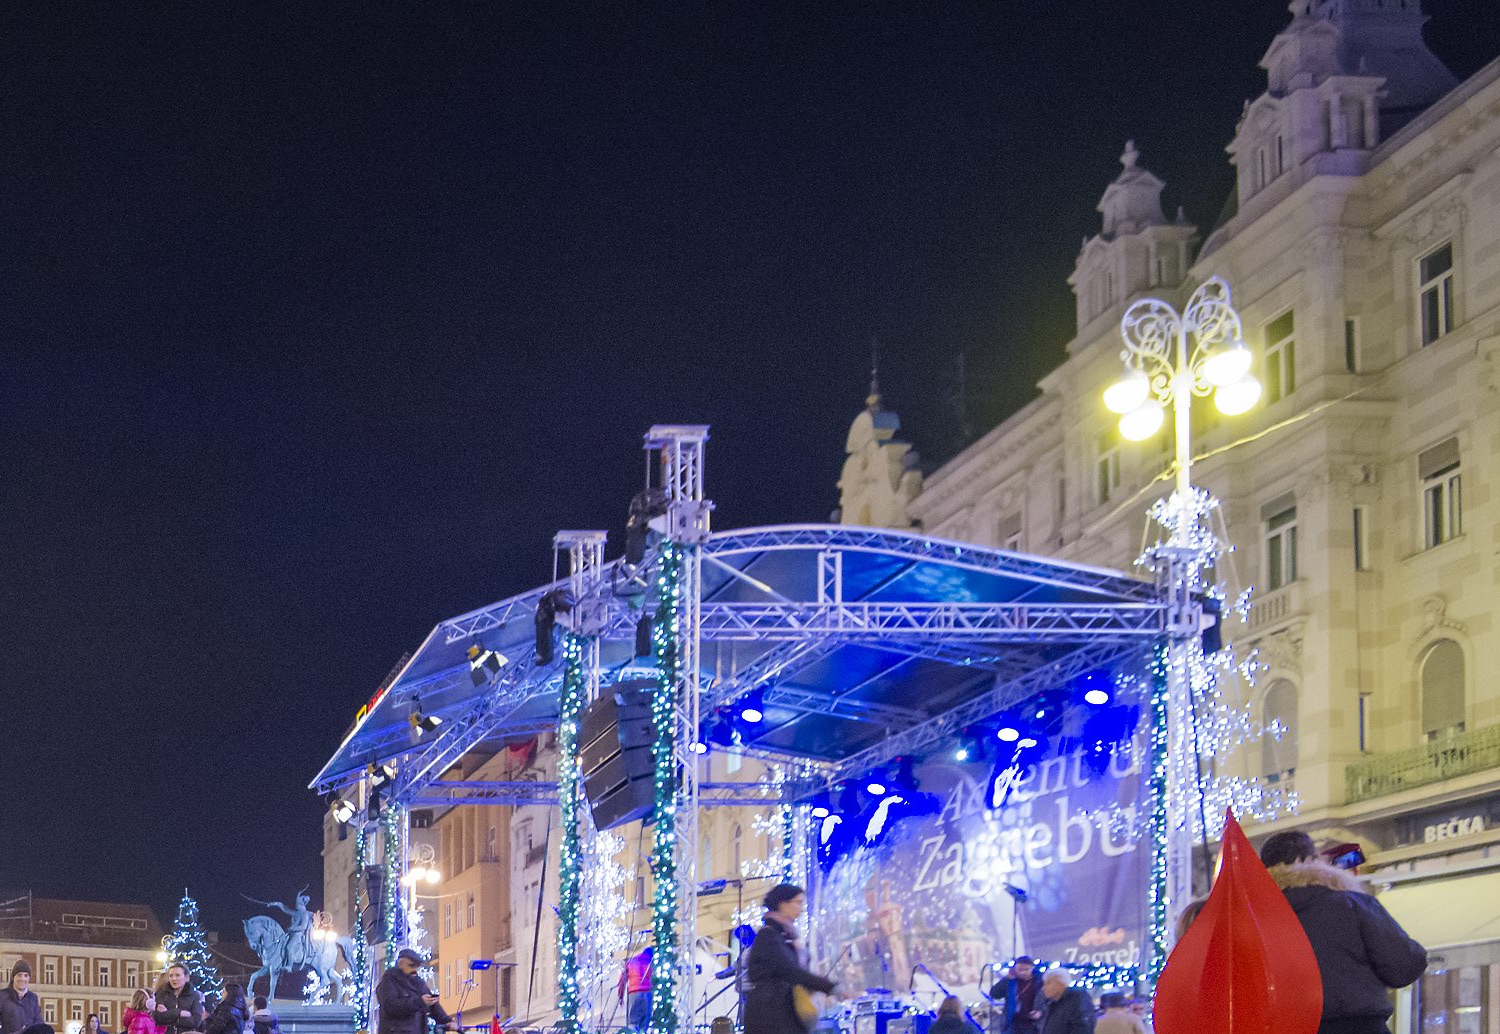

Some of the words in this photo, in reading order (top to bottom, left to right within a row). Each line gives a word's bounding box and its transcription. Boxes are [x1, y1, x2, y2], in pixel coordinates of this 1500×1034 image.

[934, 741, 1090, 827] Adent
[912, 796, 1138, 898] Zagrebu
[1424, 815, 1485, 843] BEČKA
